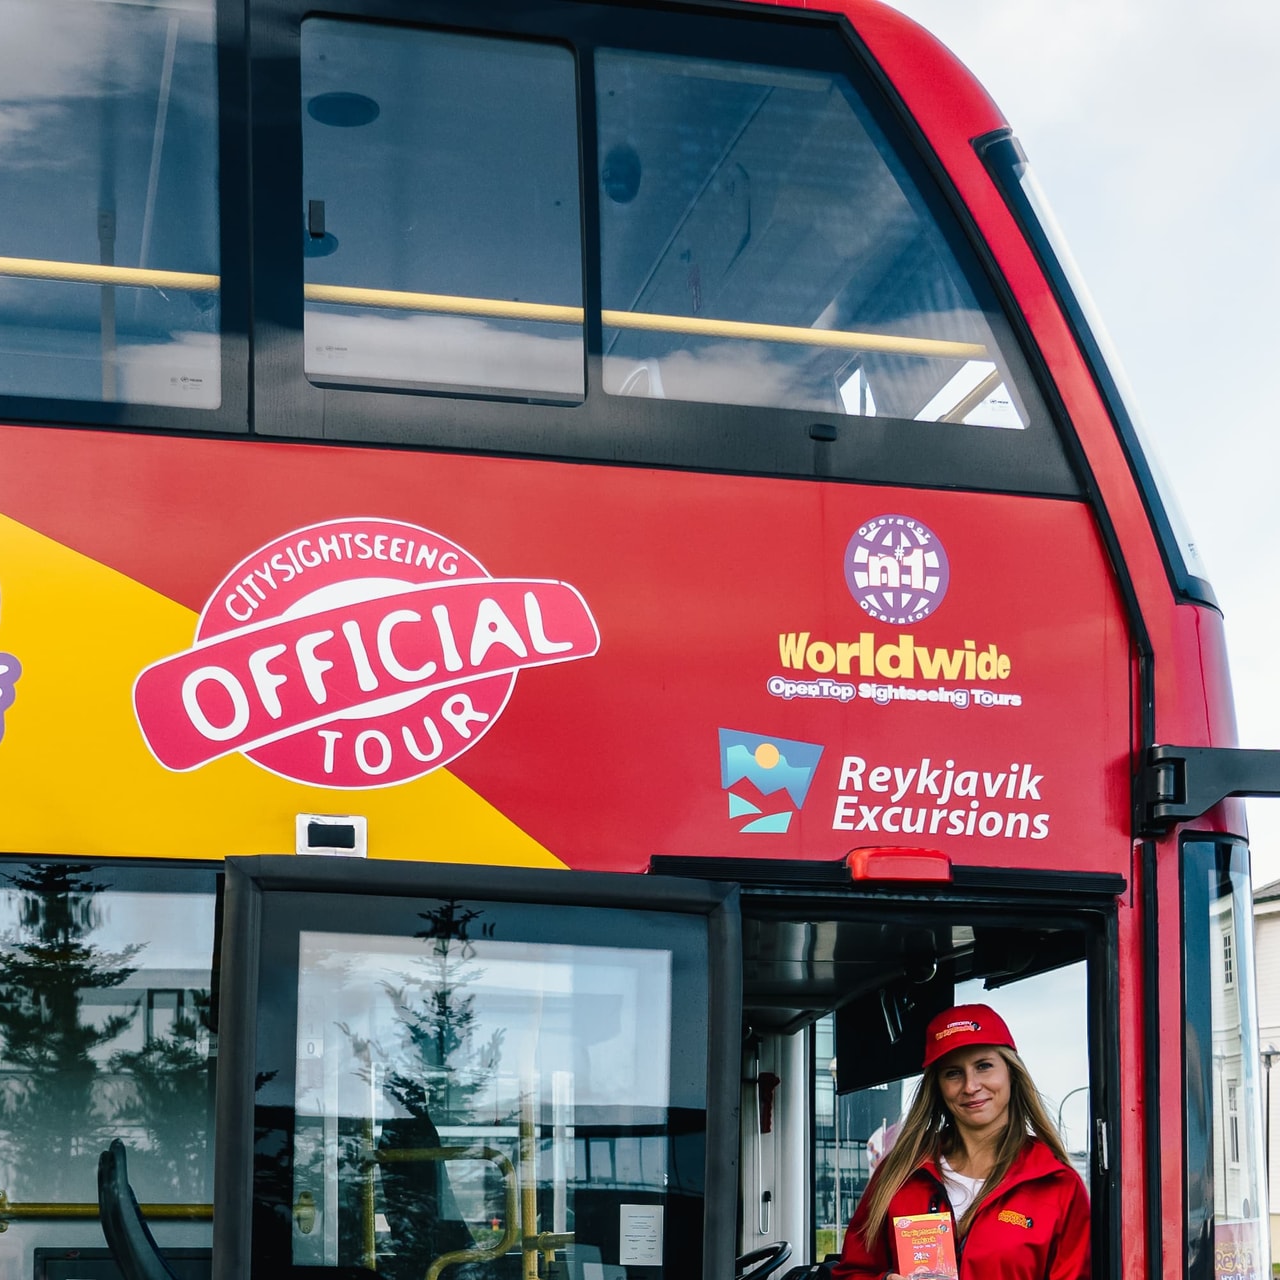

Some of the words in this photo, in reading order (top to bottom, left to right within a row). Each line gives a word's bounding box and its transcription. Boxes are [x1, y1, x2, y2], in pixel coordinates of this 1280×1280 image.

[224, 531, 460, 623] CITYSIGHTSEEING
[180, 591, 574, 742] OFFICIAL
[778, 631, 1011, 681] Worldwide
[858, 682, 967, 707] Sightseeing
[970, 689, 1022, 707] Tours
[317, 693, 490, 775] TOUR
[837, 755, 1045, 805] Reykjavik
[831, 795, 1051, 840] Excursions
